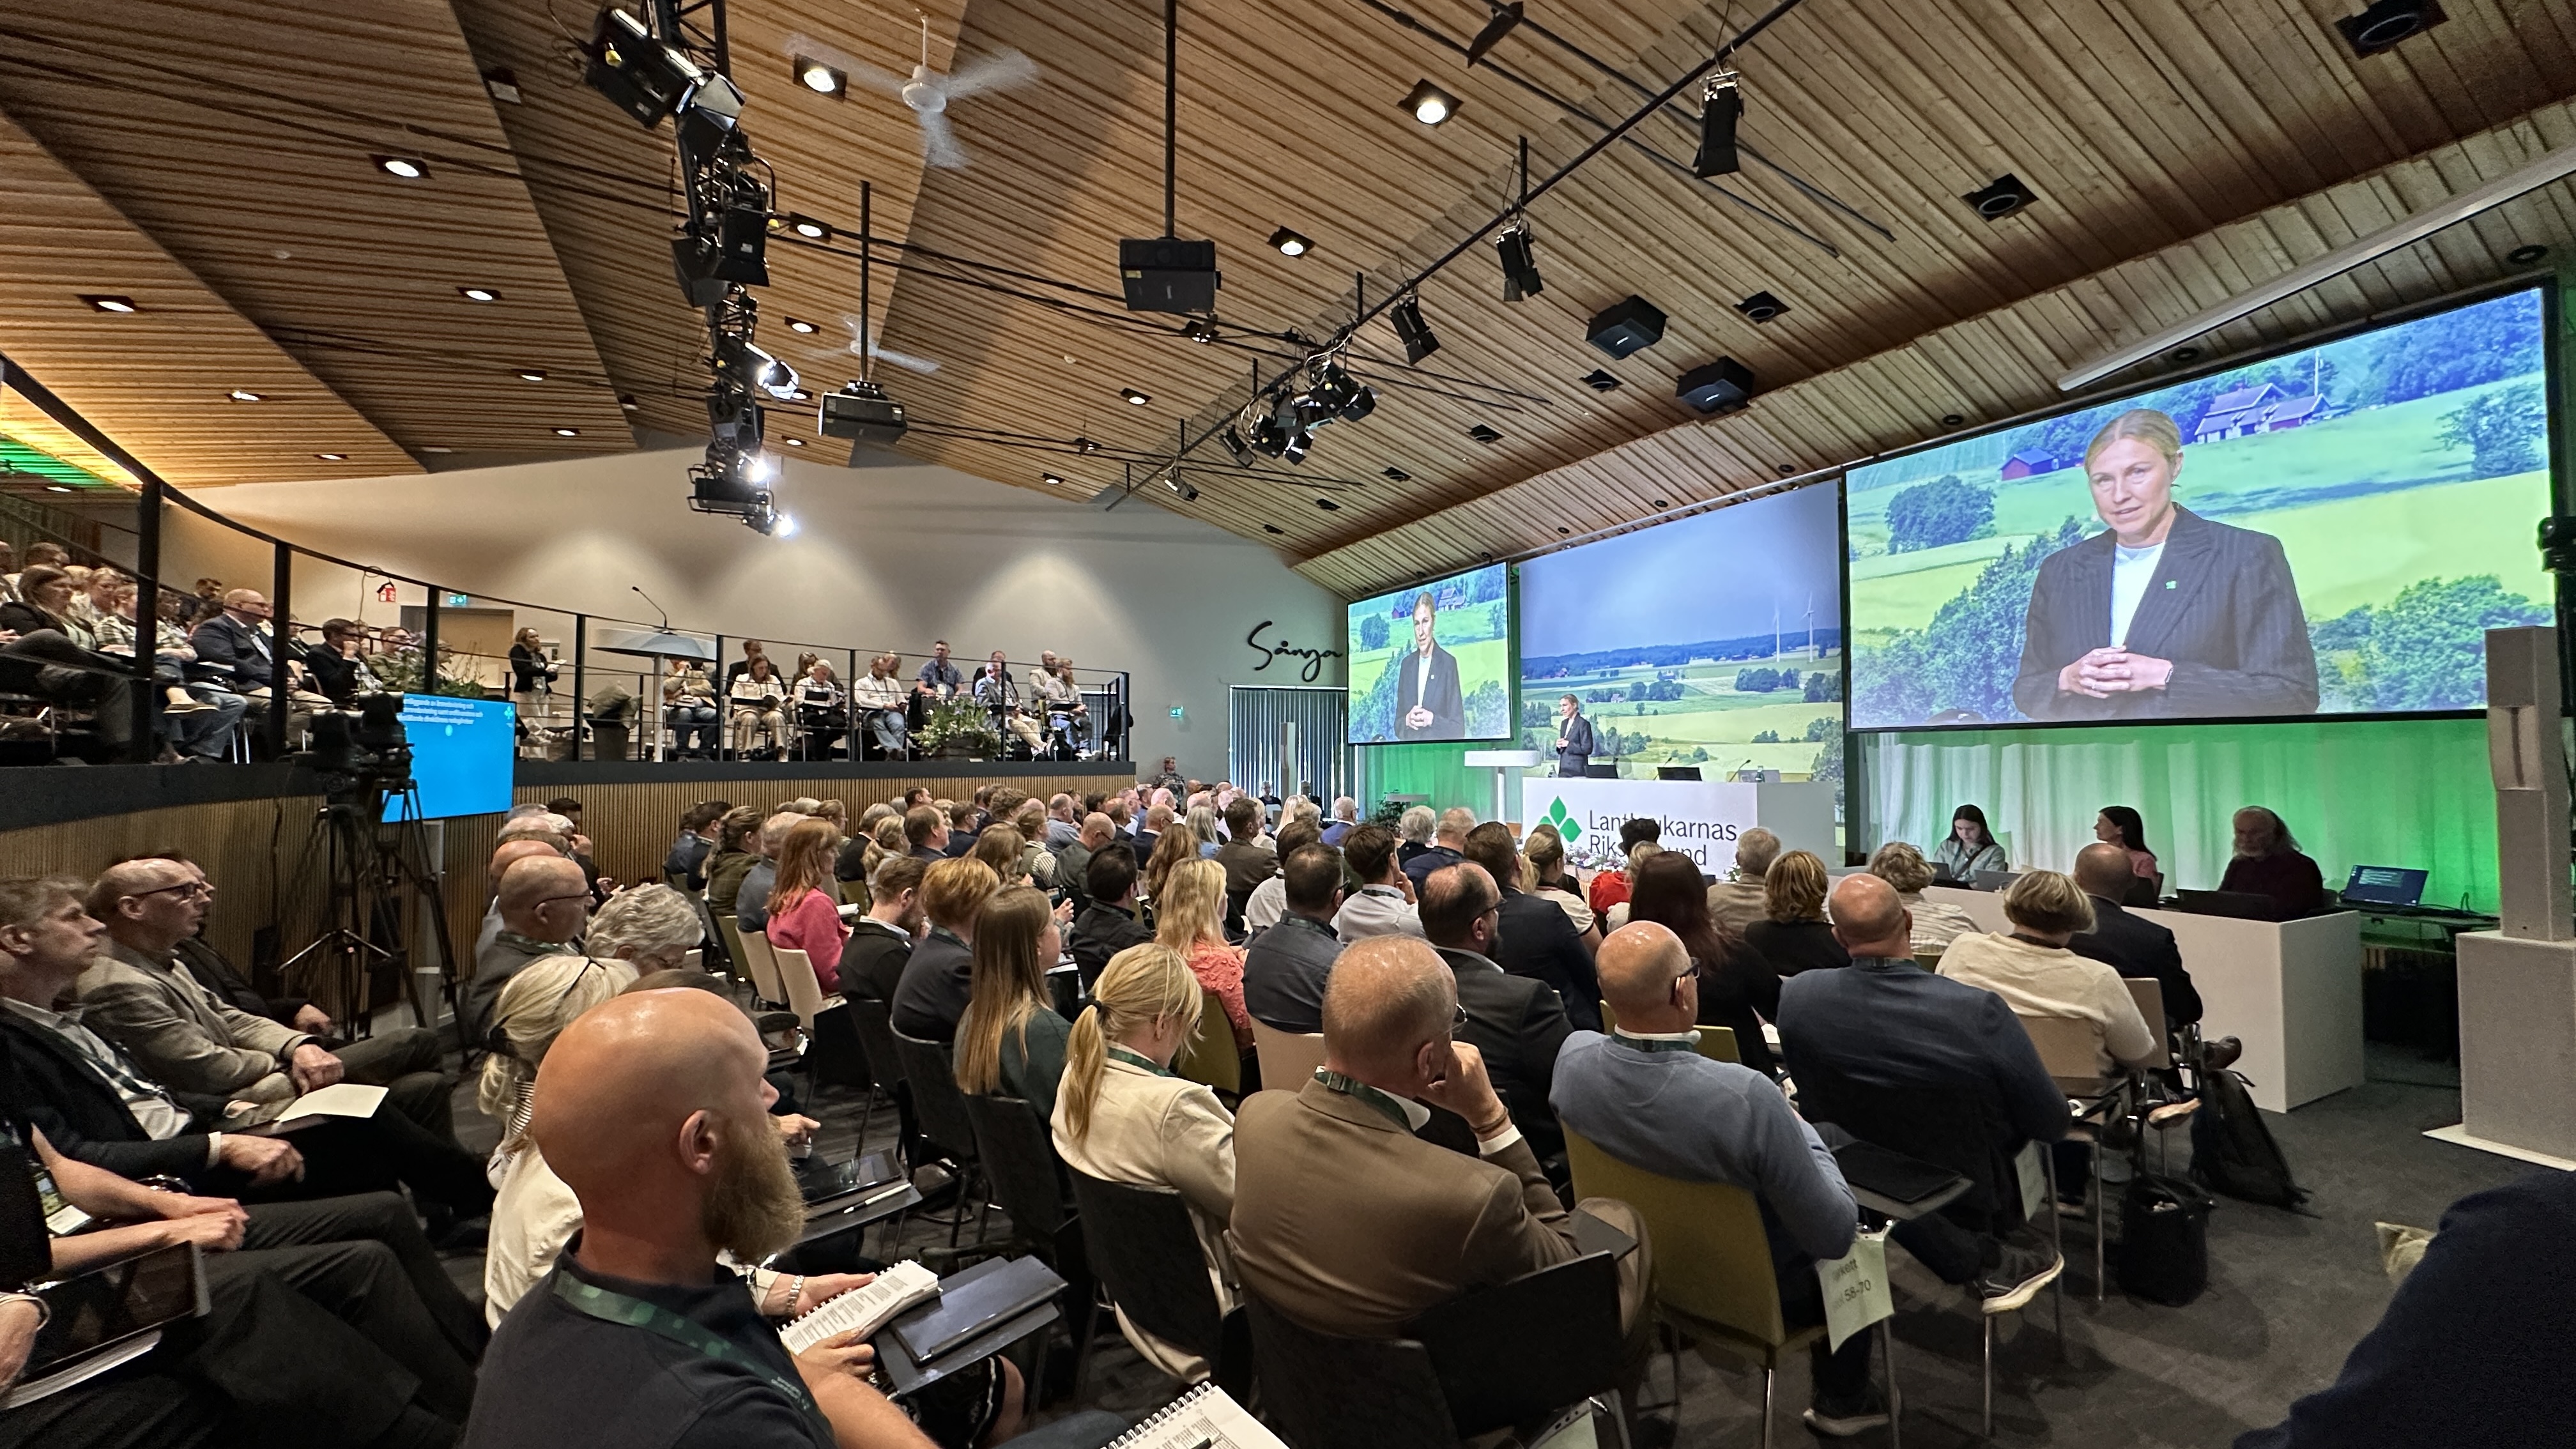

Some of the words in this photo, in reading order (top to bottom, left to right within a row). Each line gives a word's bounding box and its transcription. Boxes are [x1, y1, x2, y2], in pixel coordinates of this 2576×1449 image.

[1248, 620, 1342, 682] Sånga
[1590, 809, 1737, 841] Lantkarnas
[1844, 1279, 1871, 1301] 58-70
